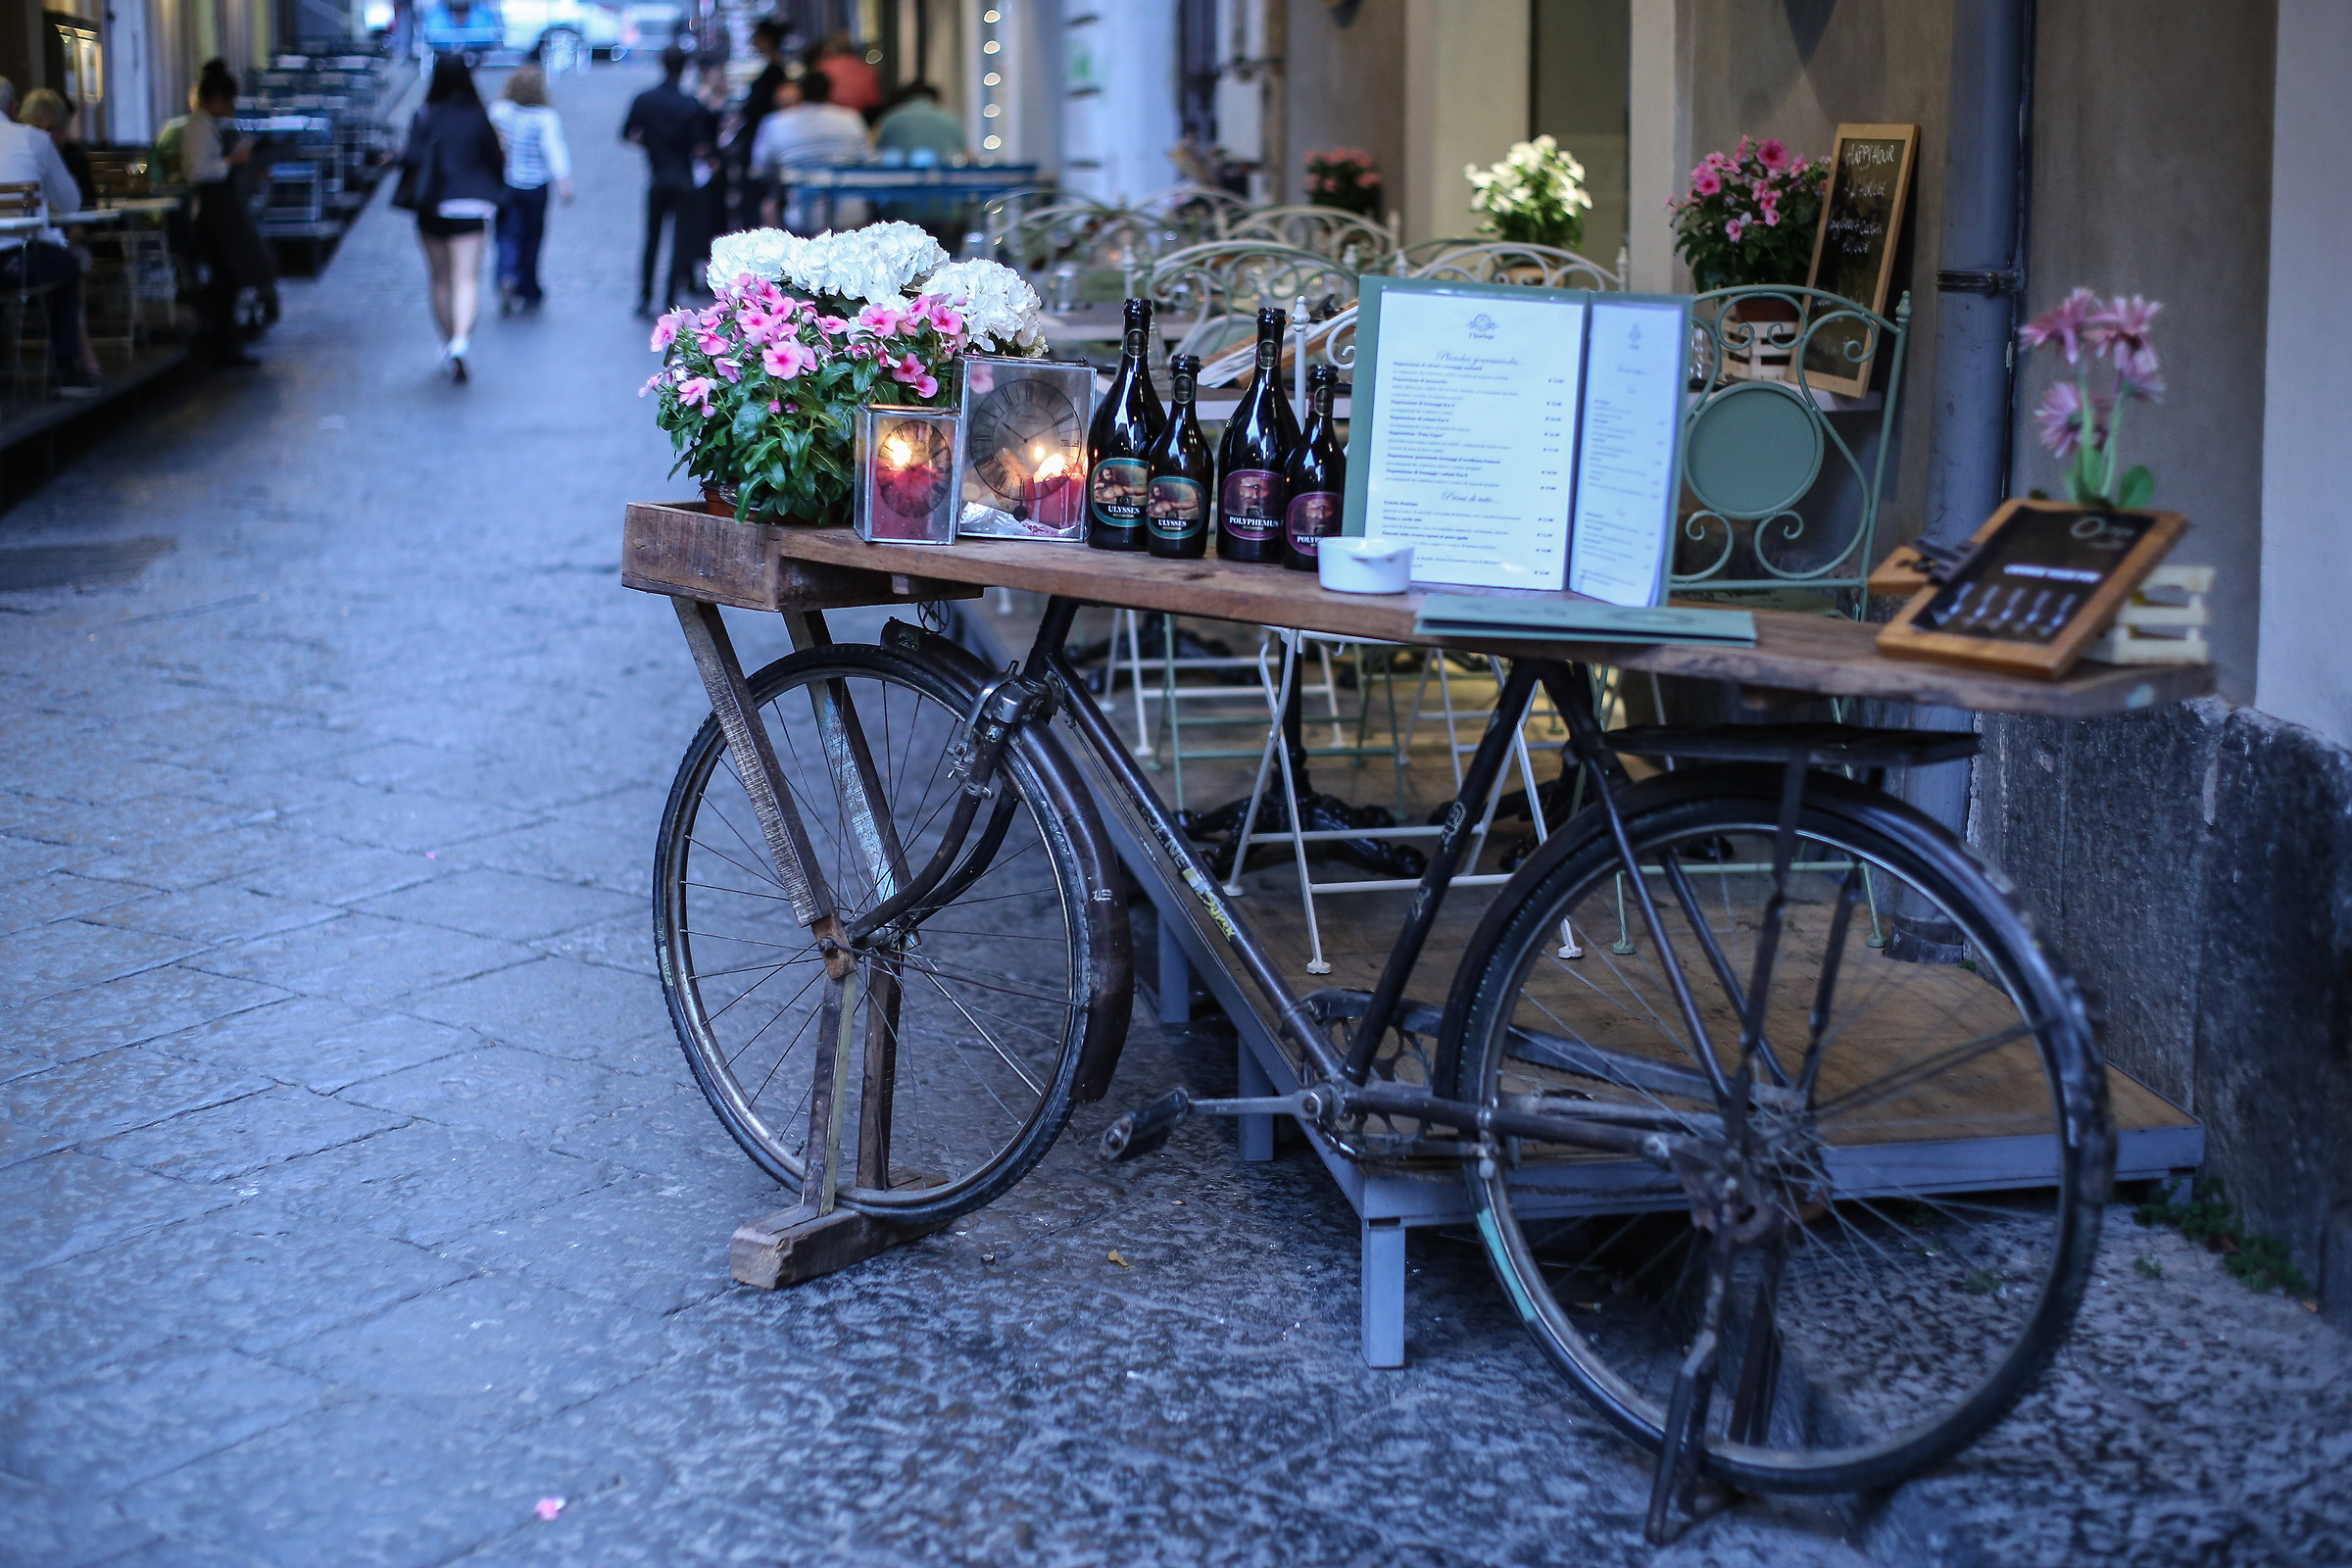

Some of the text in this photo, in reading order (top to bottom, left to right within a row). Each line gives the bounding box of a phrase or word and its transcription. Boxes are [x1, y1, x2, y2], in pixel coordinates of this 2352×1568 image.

[1107, 505, 1141, 514] ULYSSES
[1157, 518, 1188, 527] ULYSSES
[1229, 515, 1279, 527] POLYPHEMUS
